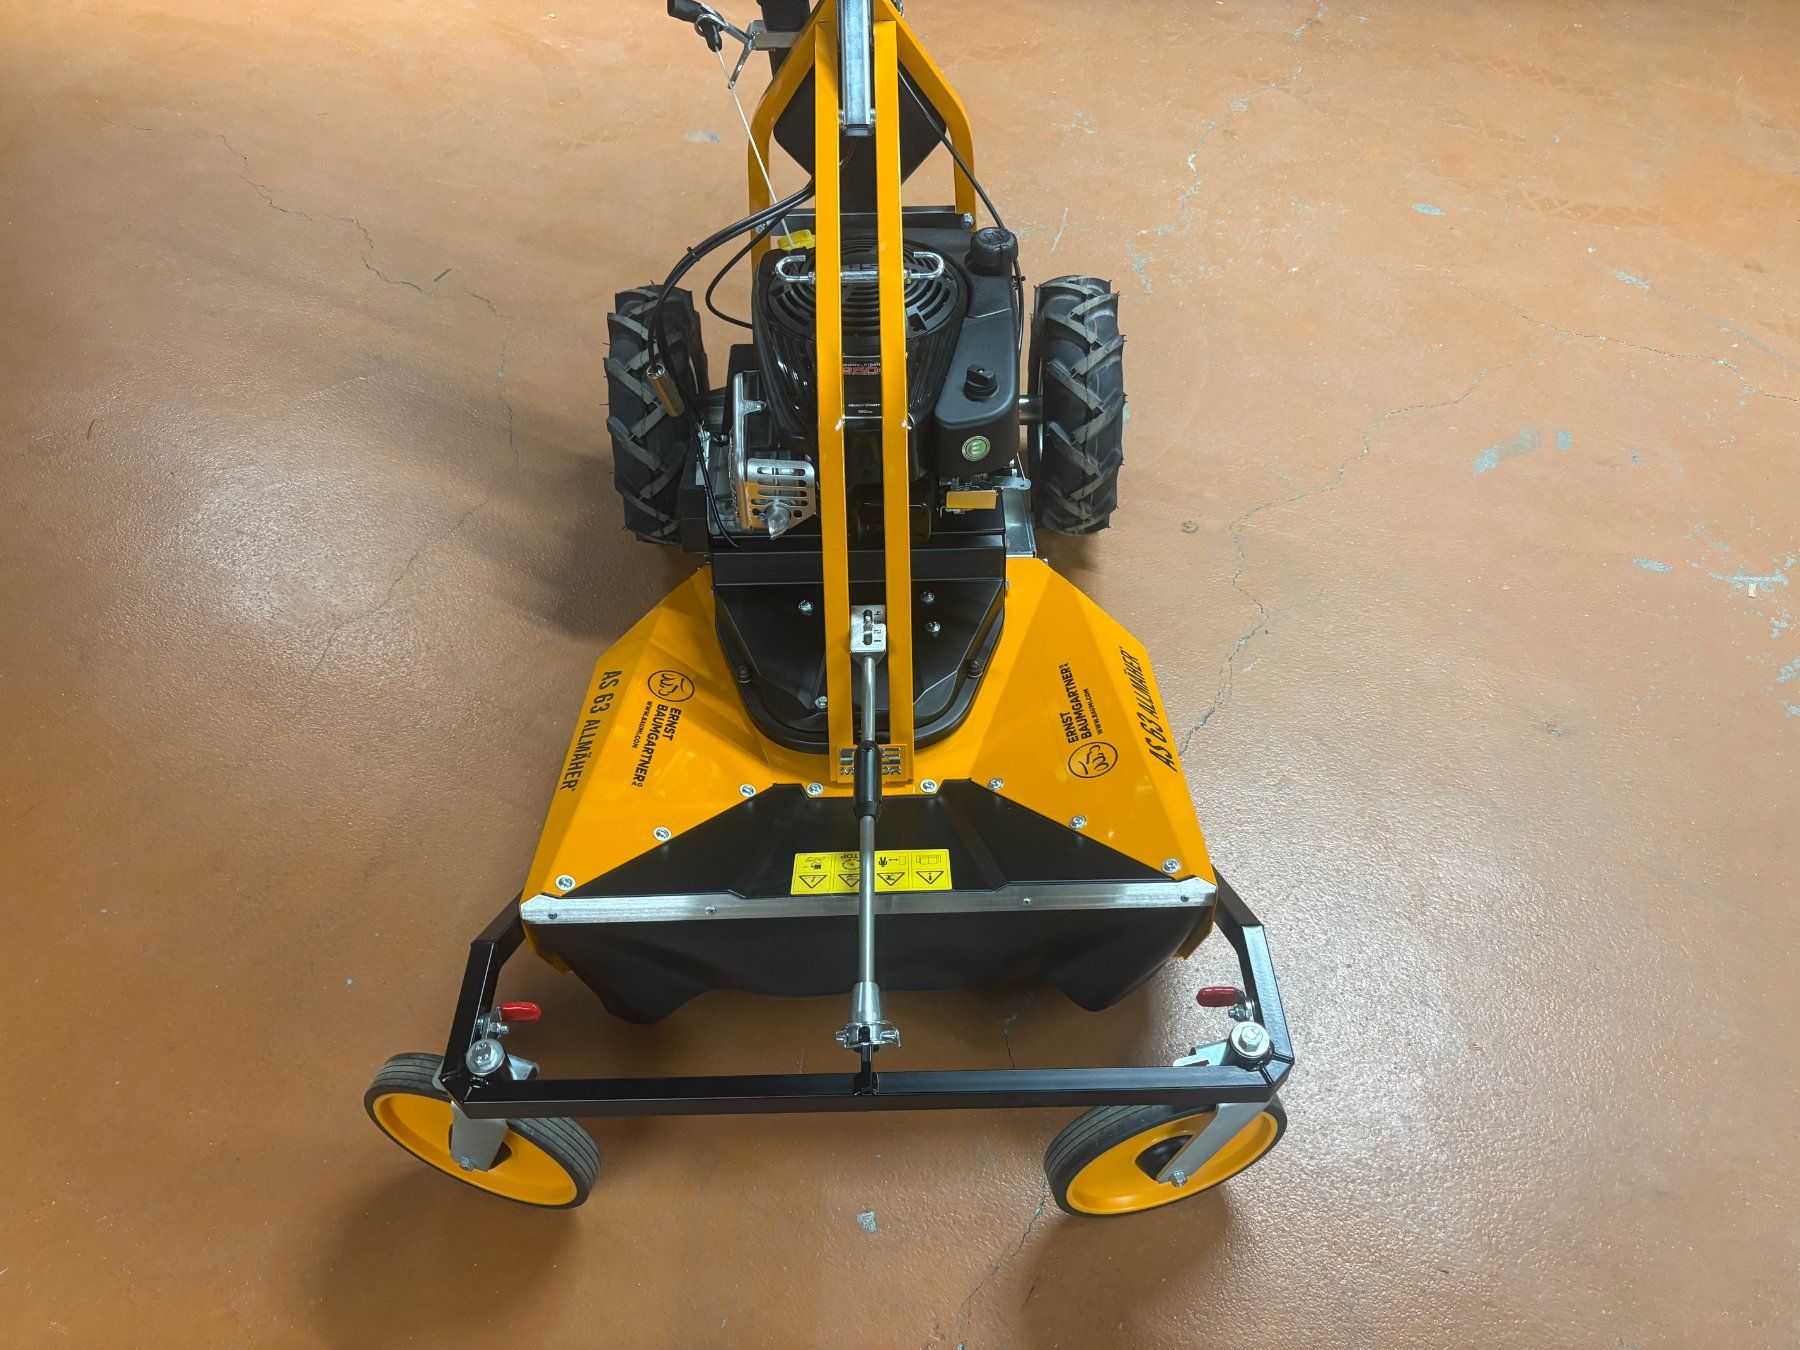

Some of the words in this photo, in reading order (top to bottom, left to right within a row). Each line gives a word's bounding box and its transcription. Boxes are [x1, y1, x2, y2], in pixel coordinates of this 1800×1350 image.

[599, 670, 623, 690] AS
[589, 692, 614, 714] 63
[1060, 667, 1092, 740] BAUMGARTNER
[663, 707, 682, 741] ERNST
[1059, 712, 1079, 744] ERNST
[1137, 711, 1168, 743] 63
[633, 703, 669, 782] BAUMGARTNER
[1145, 738, 1177, 773] AS
